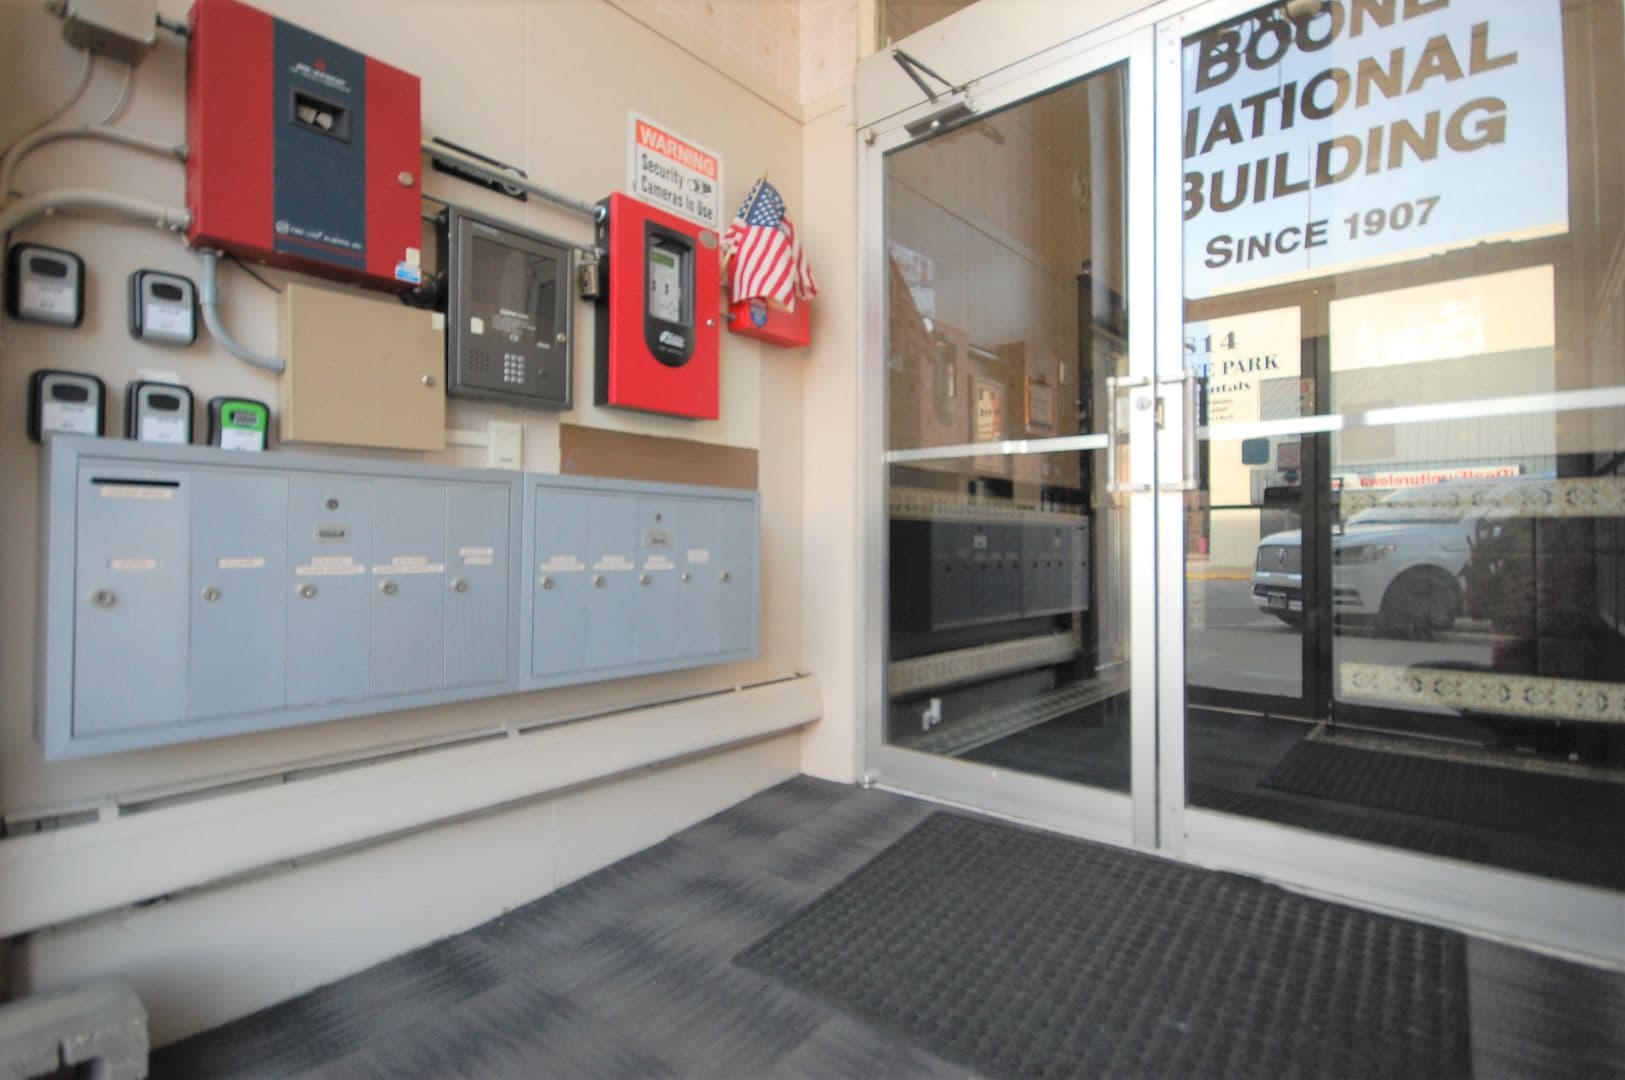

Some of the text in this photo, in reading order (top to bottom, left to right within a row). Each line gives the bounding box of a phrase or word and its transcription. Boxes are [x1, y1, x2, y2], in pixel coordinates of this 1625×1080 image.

[640, 124, 714, 179] WARNING
[641, 153, 684, 191] Security
[641, 175, 683, 207] Cameras
[1204, 196, 1441, 269] SINCE 1907
[1222, 354, 1280, 375] PARK
